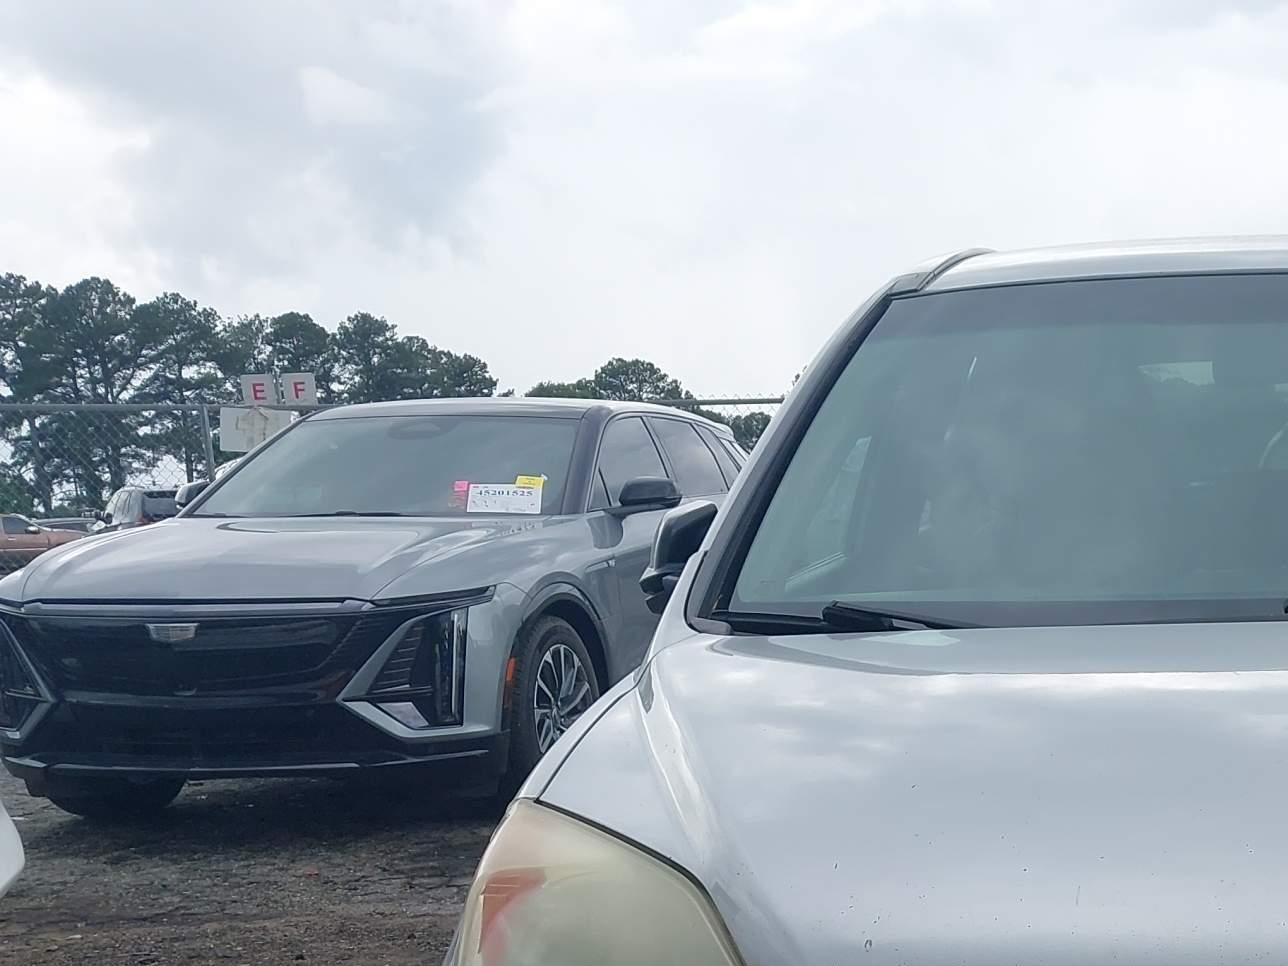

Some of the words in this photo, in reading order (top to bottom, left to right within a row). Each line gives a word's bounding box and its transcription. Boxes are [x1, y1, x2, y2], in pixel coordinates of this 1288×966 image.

[252, 383, 267, 401] E
[292, 382, 306, 400] F
[476, 489, 533, 497] 45201525
